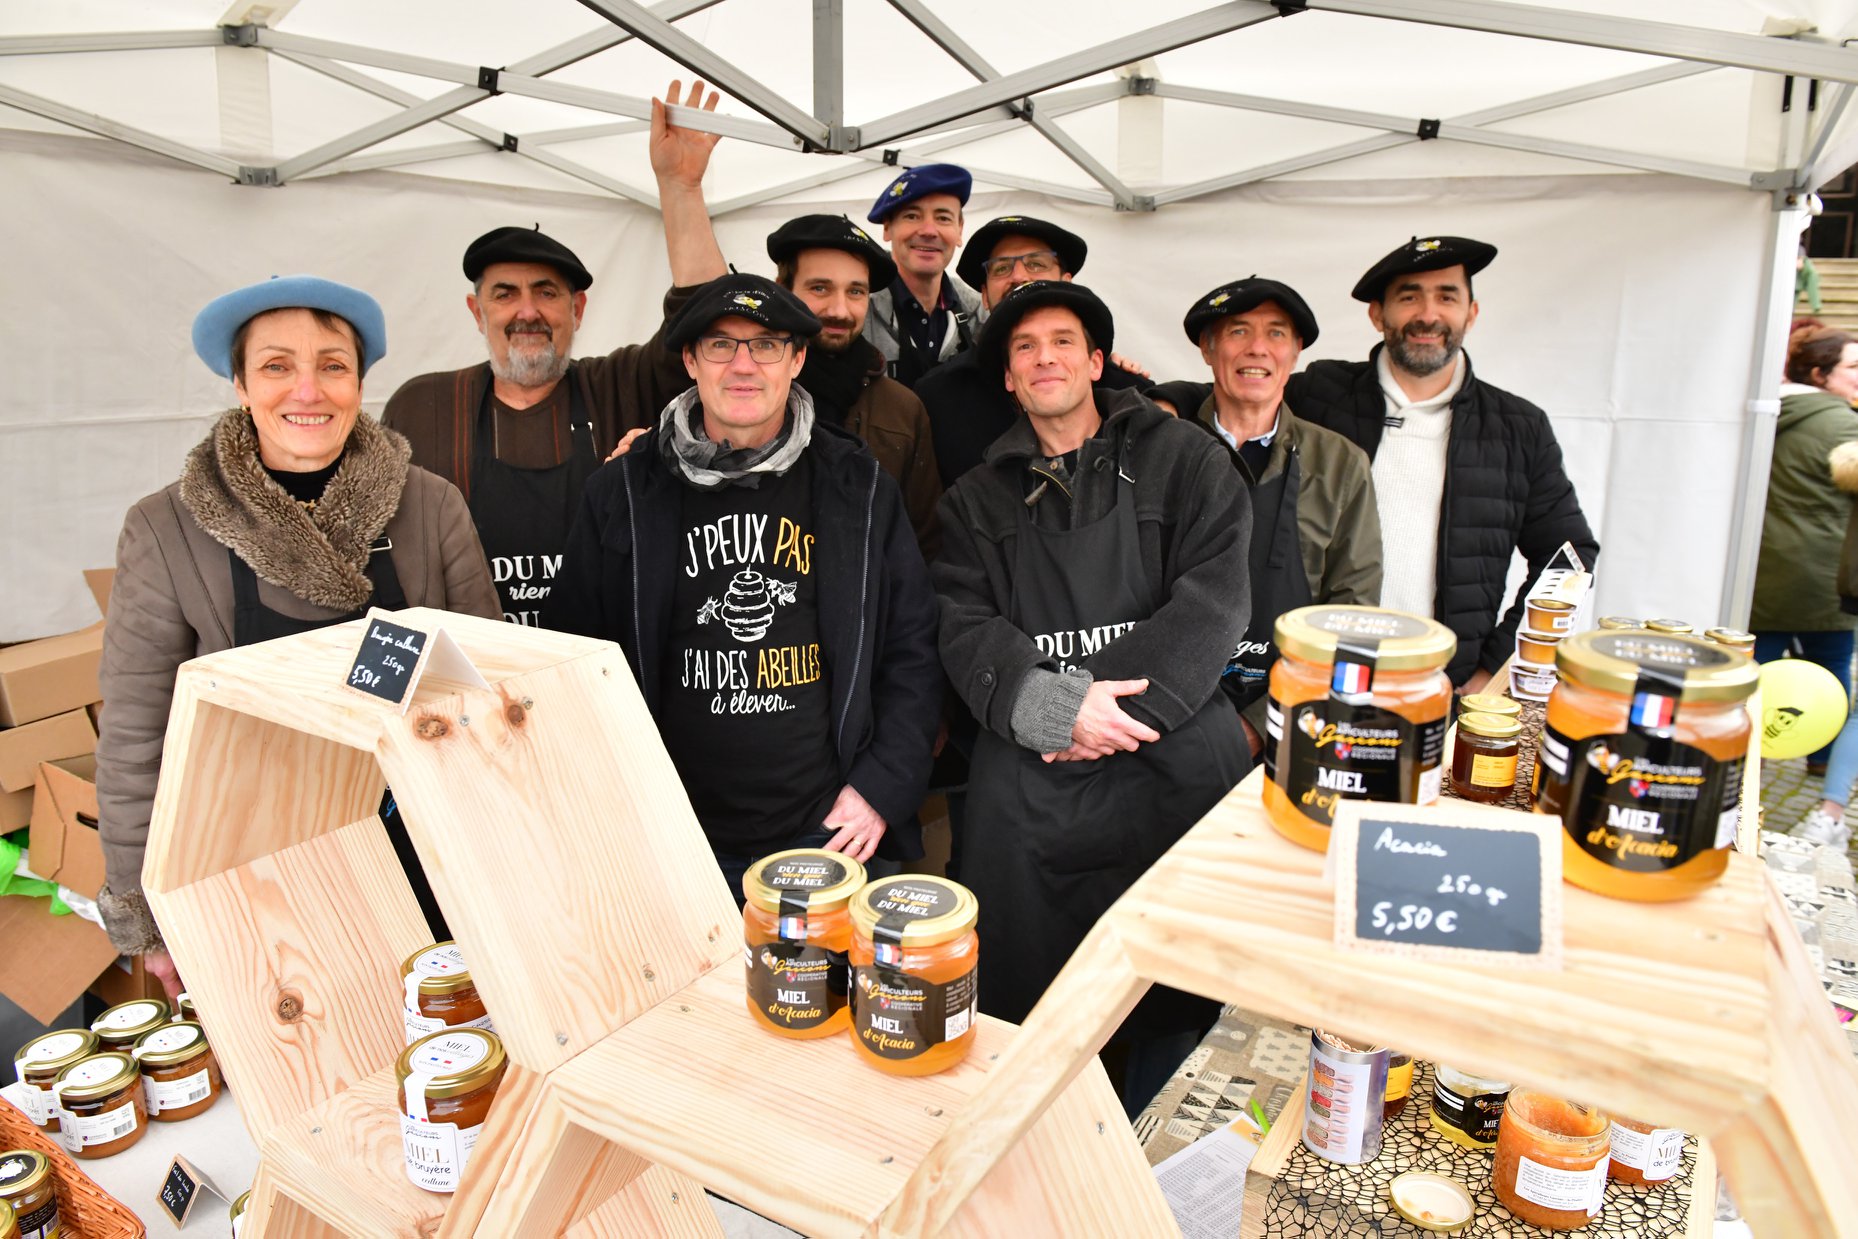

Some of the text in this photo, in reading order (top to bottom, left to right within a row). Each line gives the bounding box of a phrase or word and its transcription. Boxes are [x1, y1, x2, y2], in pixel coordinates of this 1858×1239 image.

[686, 514, 815, 577] J'PEUX PAS
[491, 555, 534, 582] DU
[1034, 631, 1075, 658] DU
[682, 643, 820, 690] J'AI DES ABEILLES
[711, 689, 796, 714] à élever...
[1318, 766, 1368, 793] MIEL
[1606, 804, 1664, 834] MIEL
[773, 877, 825, 886] DU MIEL
[798, 867, 829, 875] MIEL
[888, 888, 908, 898] DU
[907, 891, 939, 904] MIEL
[877, 900, 928, 916] DU MIEL
[785, 959, 828, 968] APICULTEURS
[777, 988, 810, 1004] MIEL
[768, 1003, 822, 1023] d'Acacia
[871, 1013, 904, 1034] MIEL
[863, 1028, 915, 1051] d'Acacia
[414, 1161, 451, 1174] bruyère
